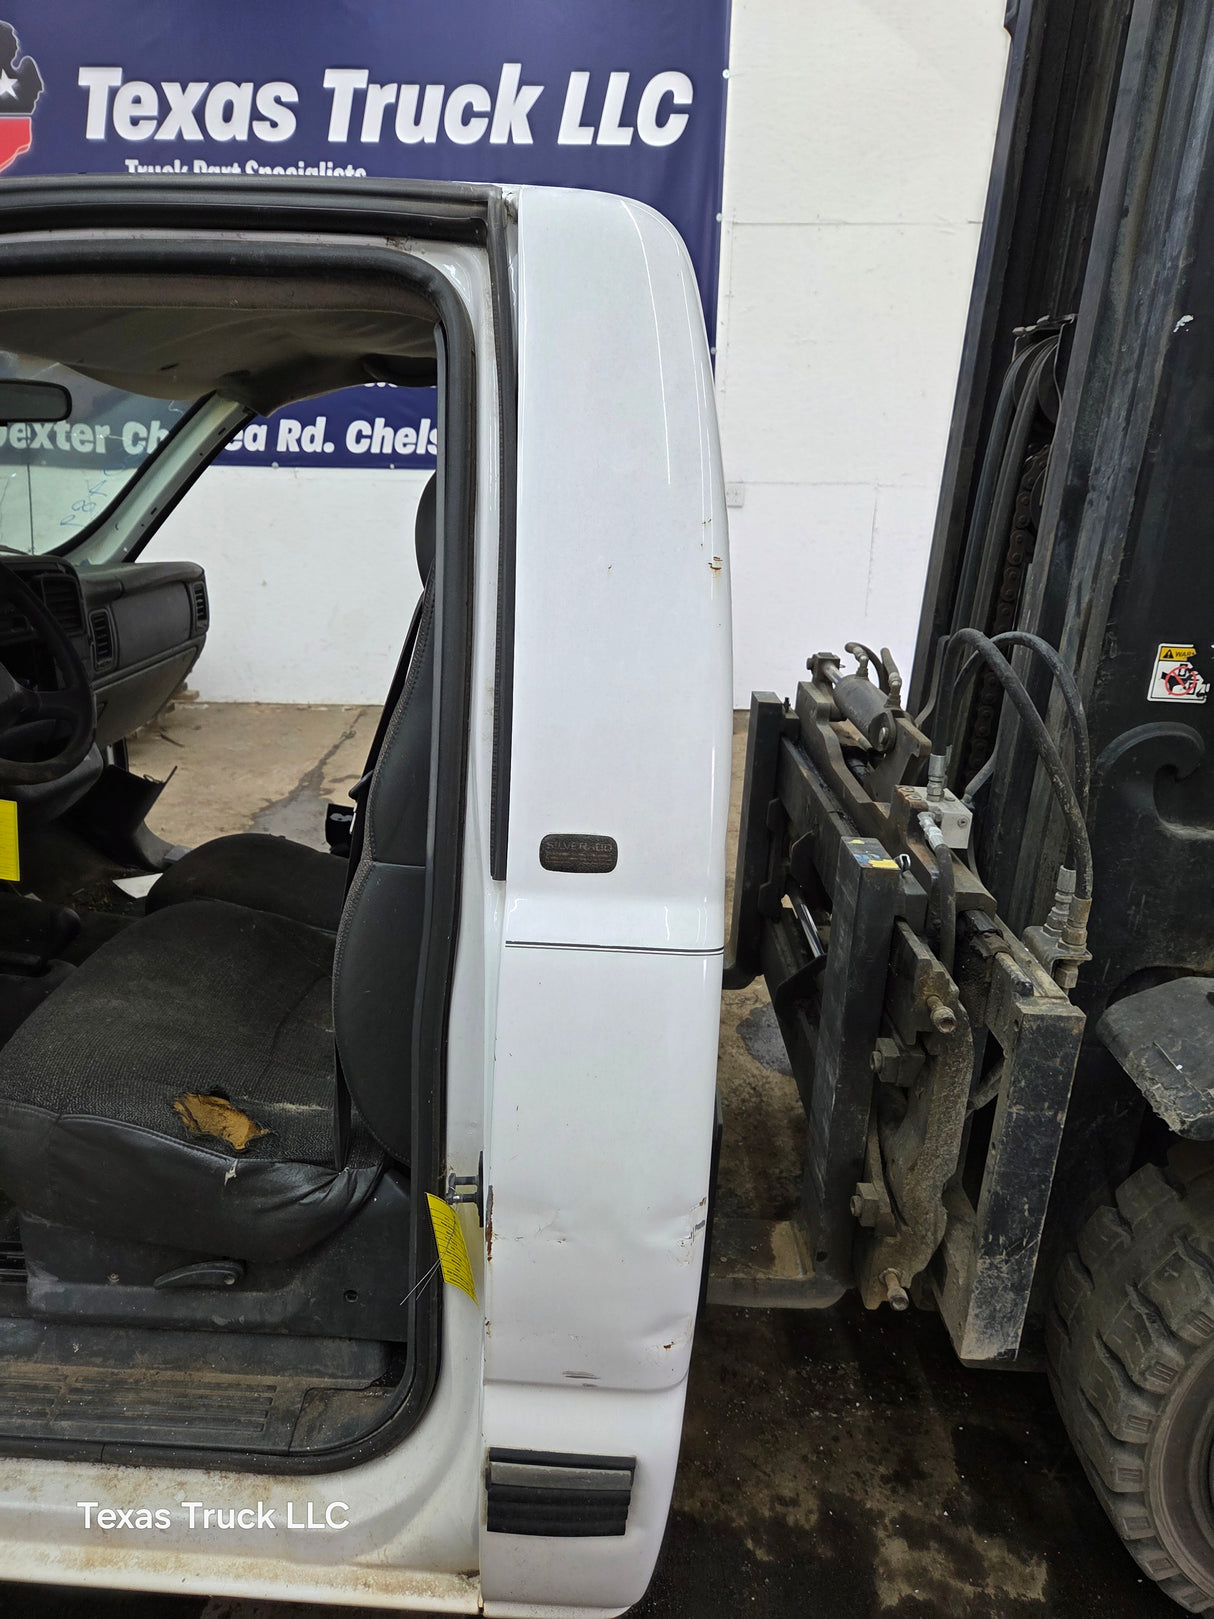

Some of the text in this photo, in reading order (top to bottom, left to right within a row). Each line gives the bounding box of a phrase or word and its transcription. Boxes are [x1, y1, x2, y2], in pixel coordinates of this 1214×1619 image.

[78, 63, 693, 147] Texas Truck LLC
[277, 416, 335, 454] Rd.
